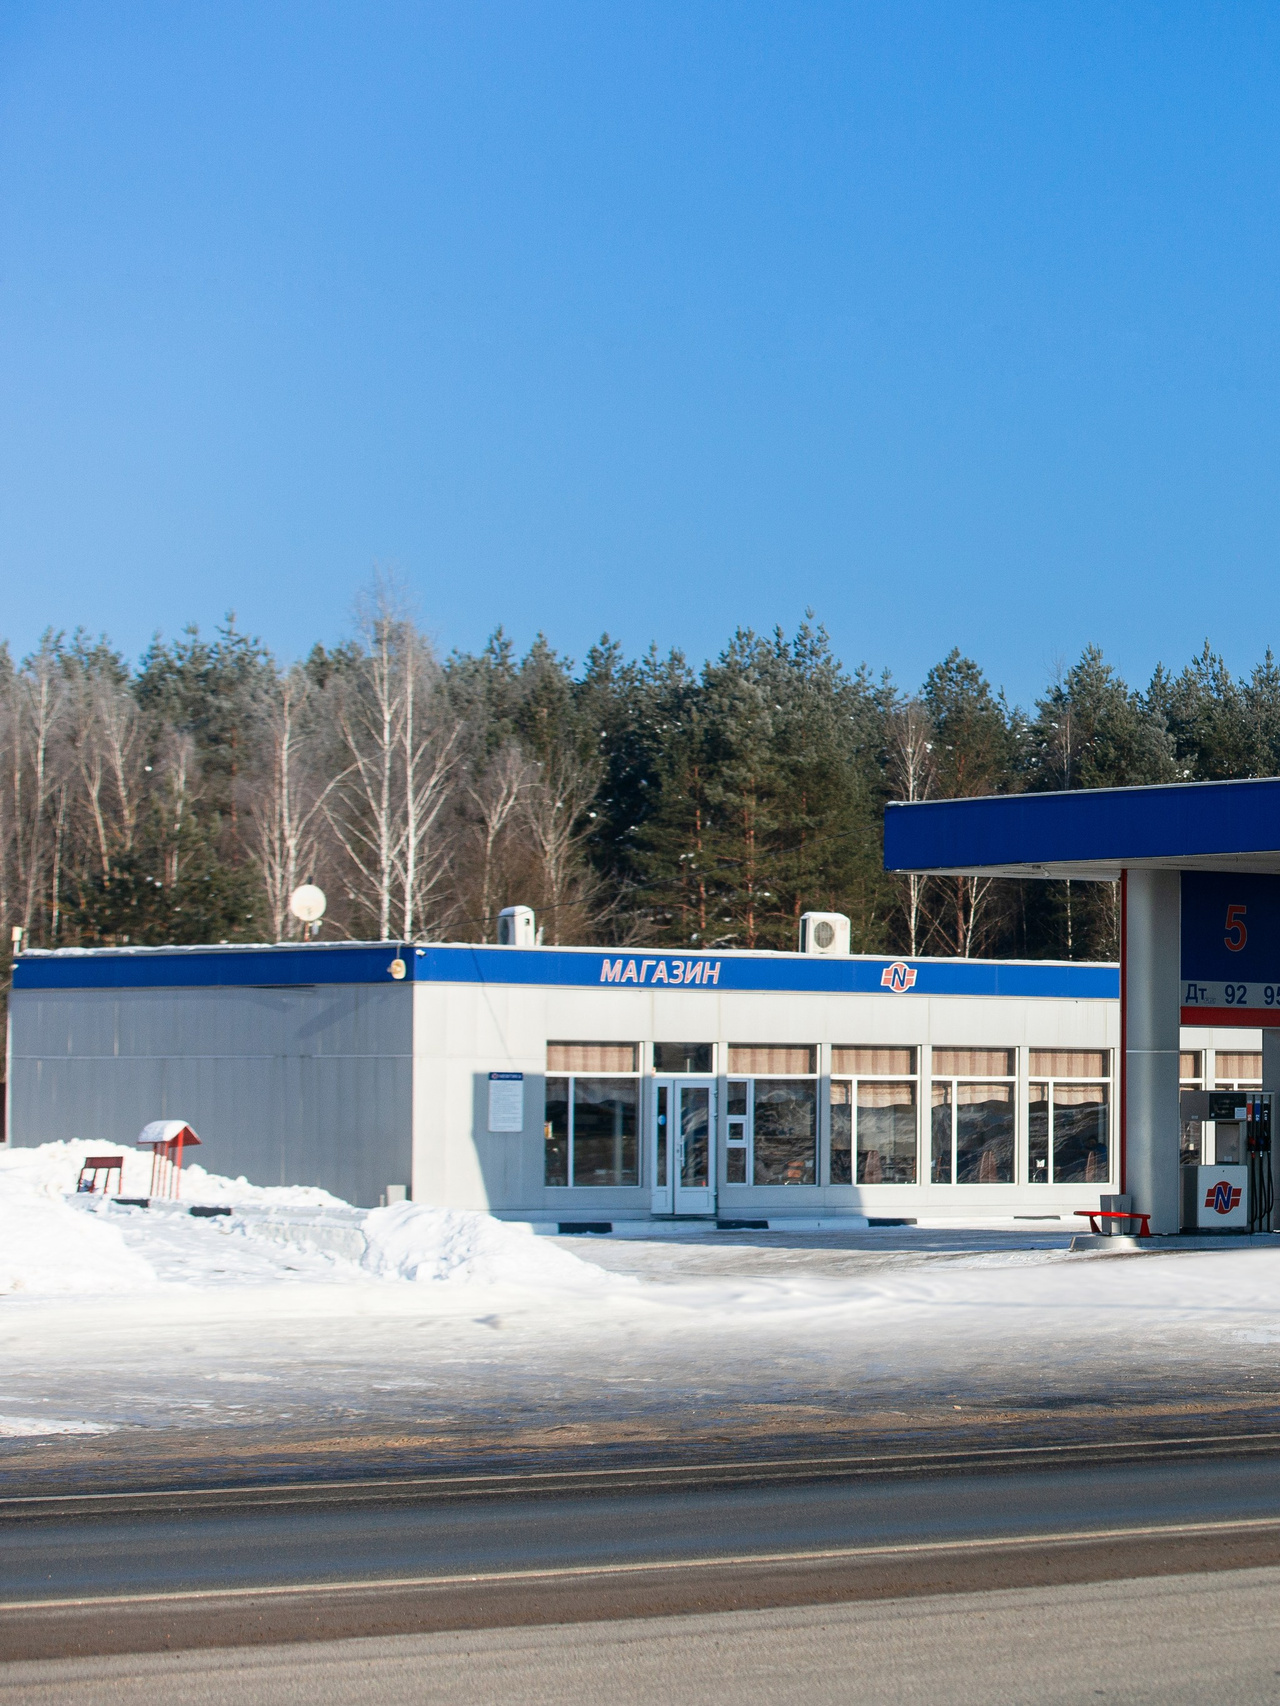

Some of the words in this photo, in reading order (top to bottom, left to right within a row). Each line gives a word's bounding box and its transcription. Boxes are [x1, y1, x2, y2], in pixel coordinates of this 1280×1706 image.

[1224, 904, 1248, 952] 5
[600, 959, 721, 985] МАГАЗИН
[1185, 983, 1207, 1004] Дт
[1224, 984, 1248, 1005] 92
